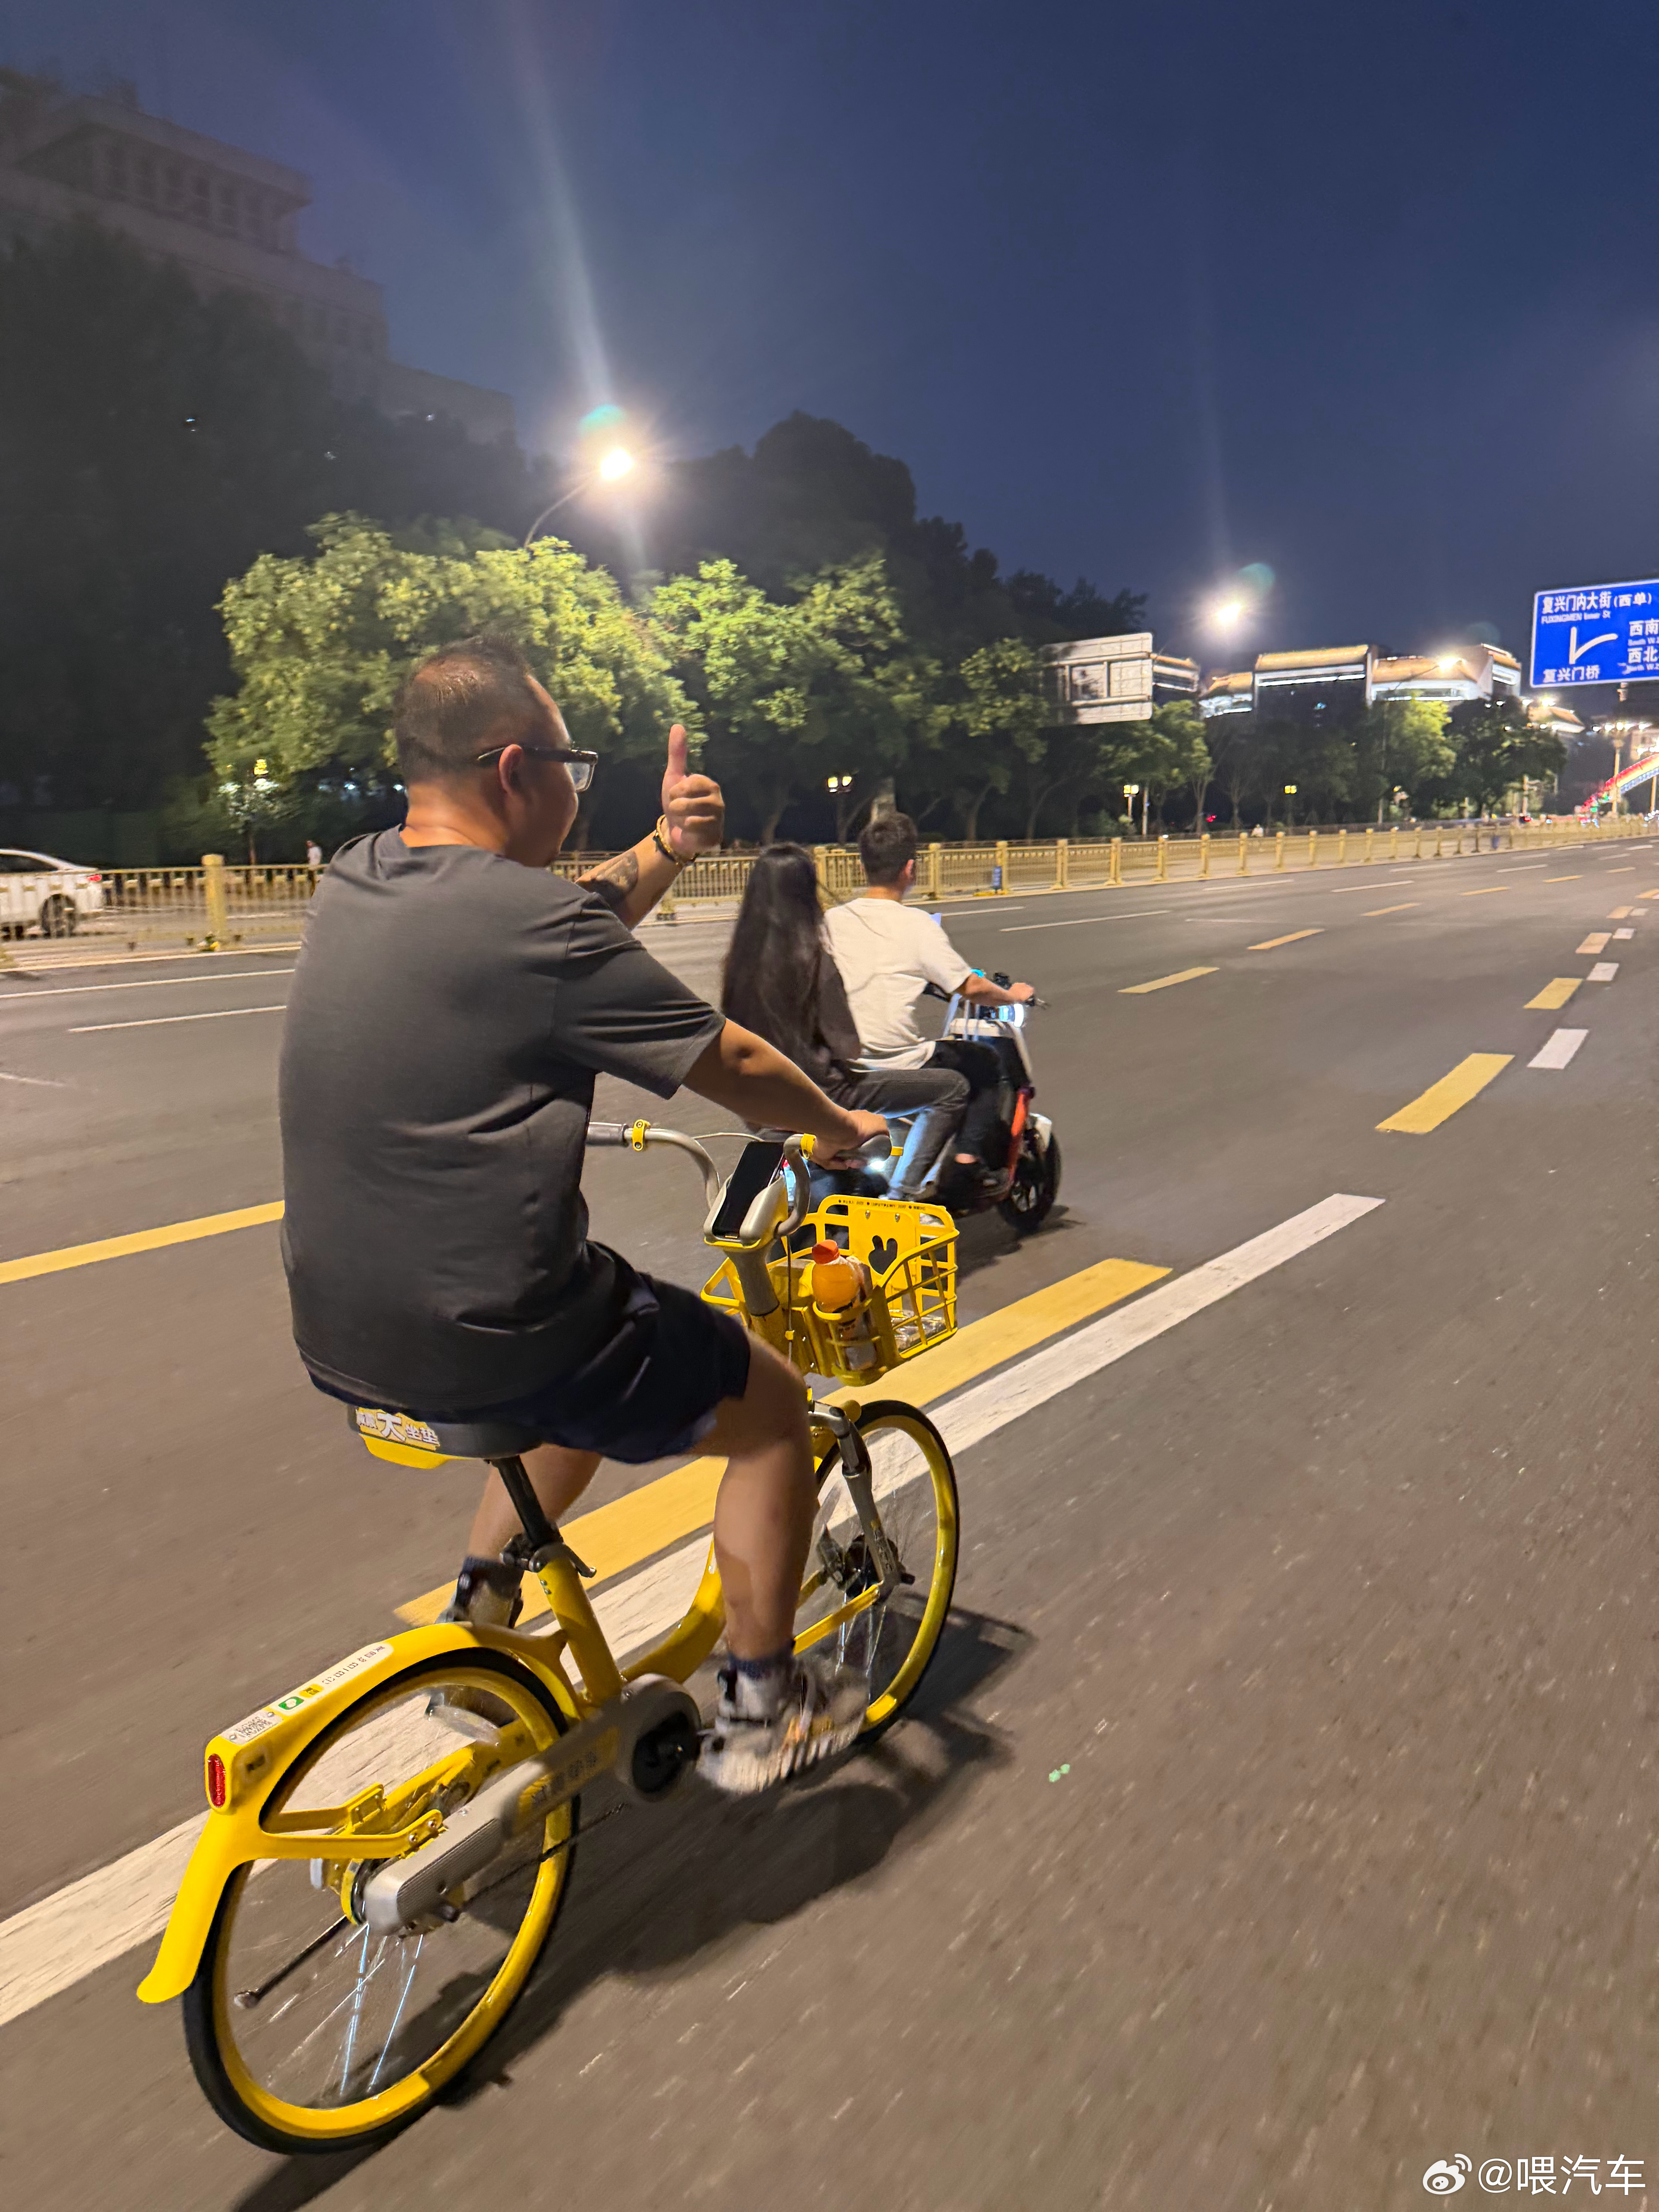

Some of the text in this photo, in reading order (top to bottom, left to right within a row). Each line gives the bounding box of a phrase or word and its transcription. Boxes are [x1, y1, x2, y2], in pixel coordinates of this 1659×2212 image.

[1627, 646, 1658, 664] 西北
[1542, 665, 1600, 683] 复兴门桥
